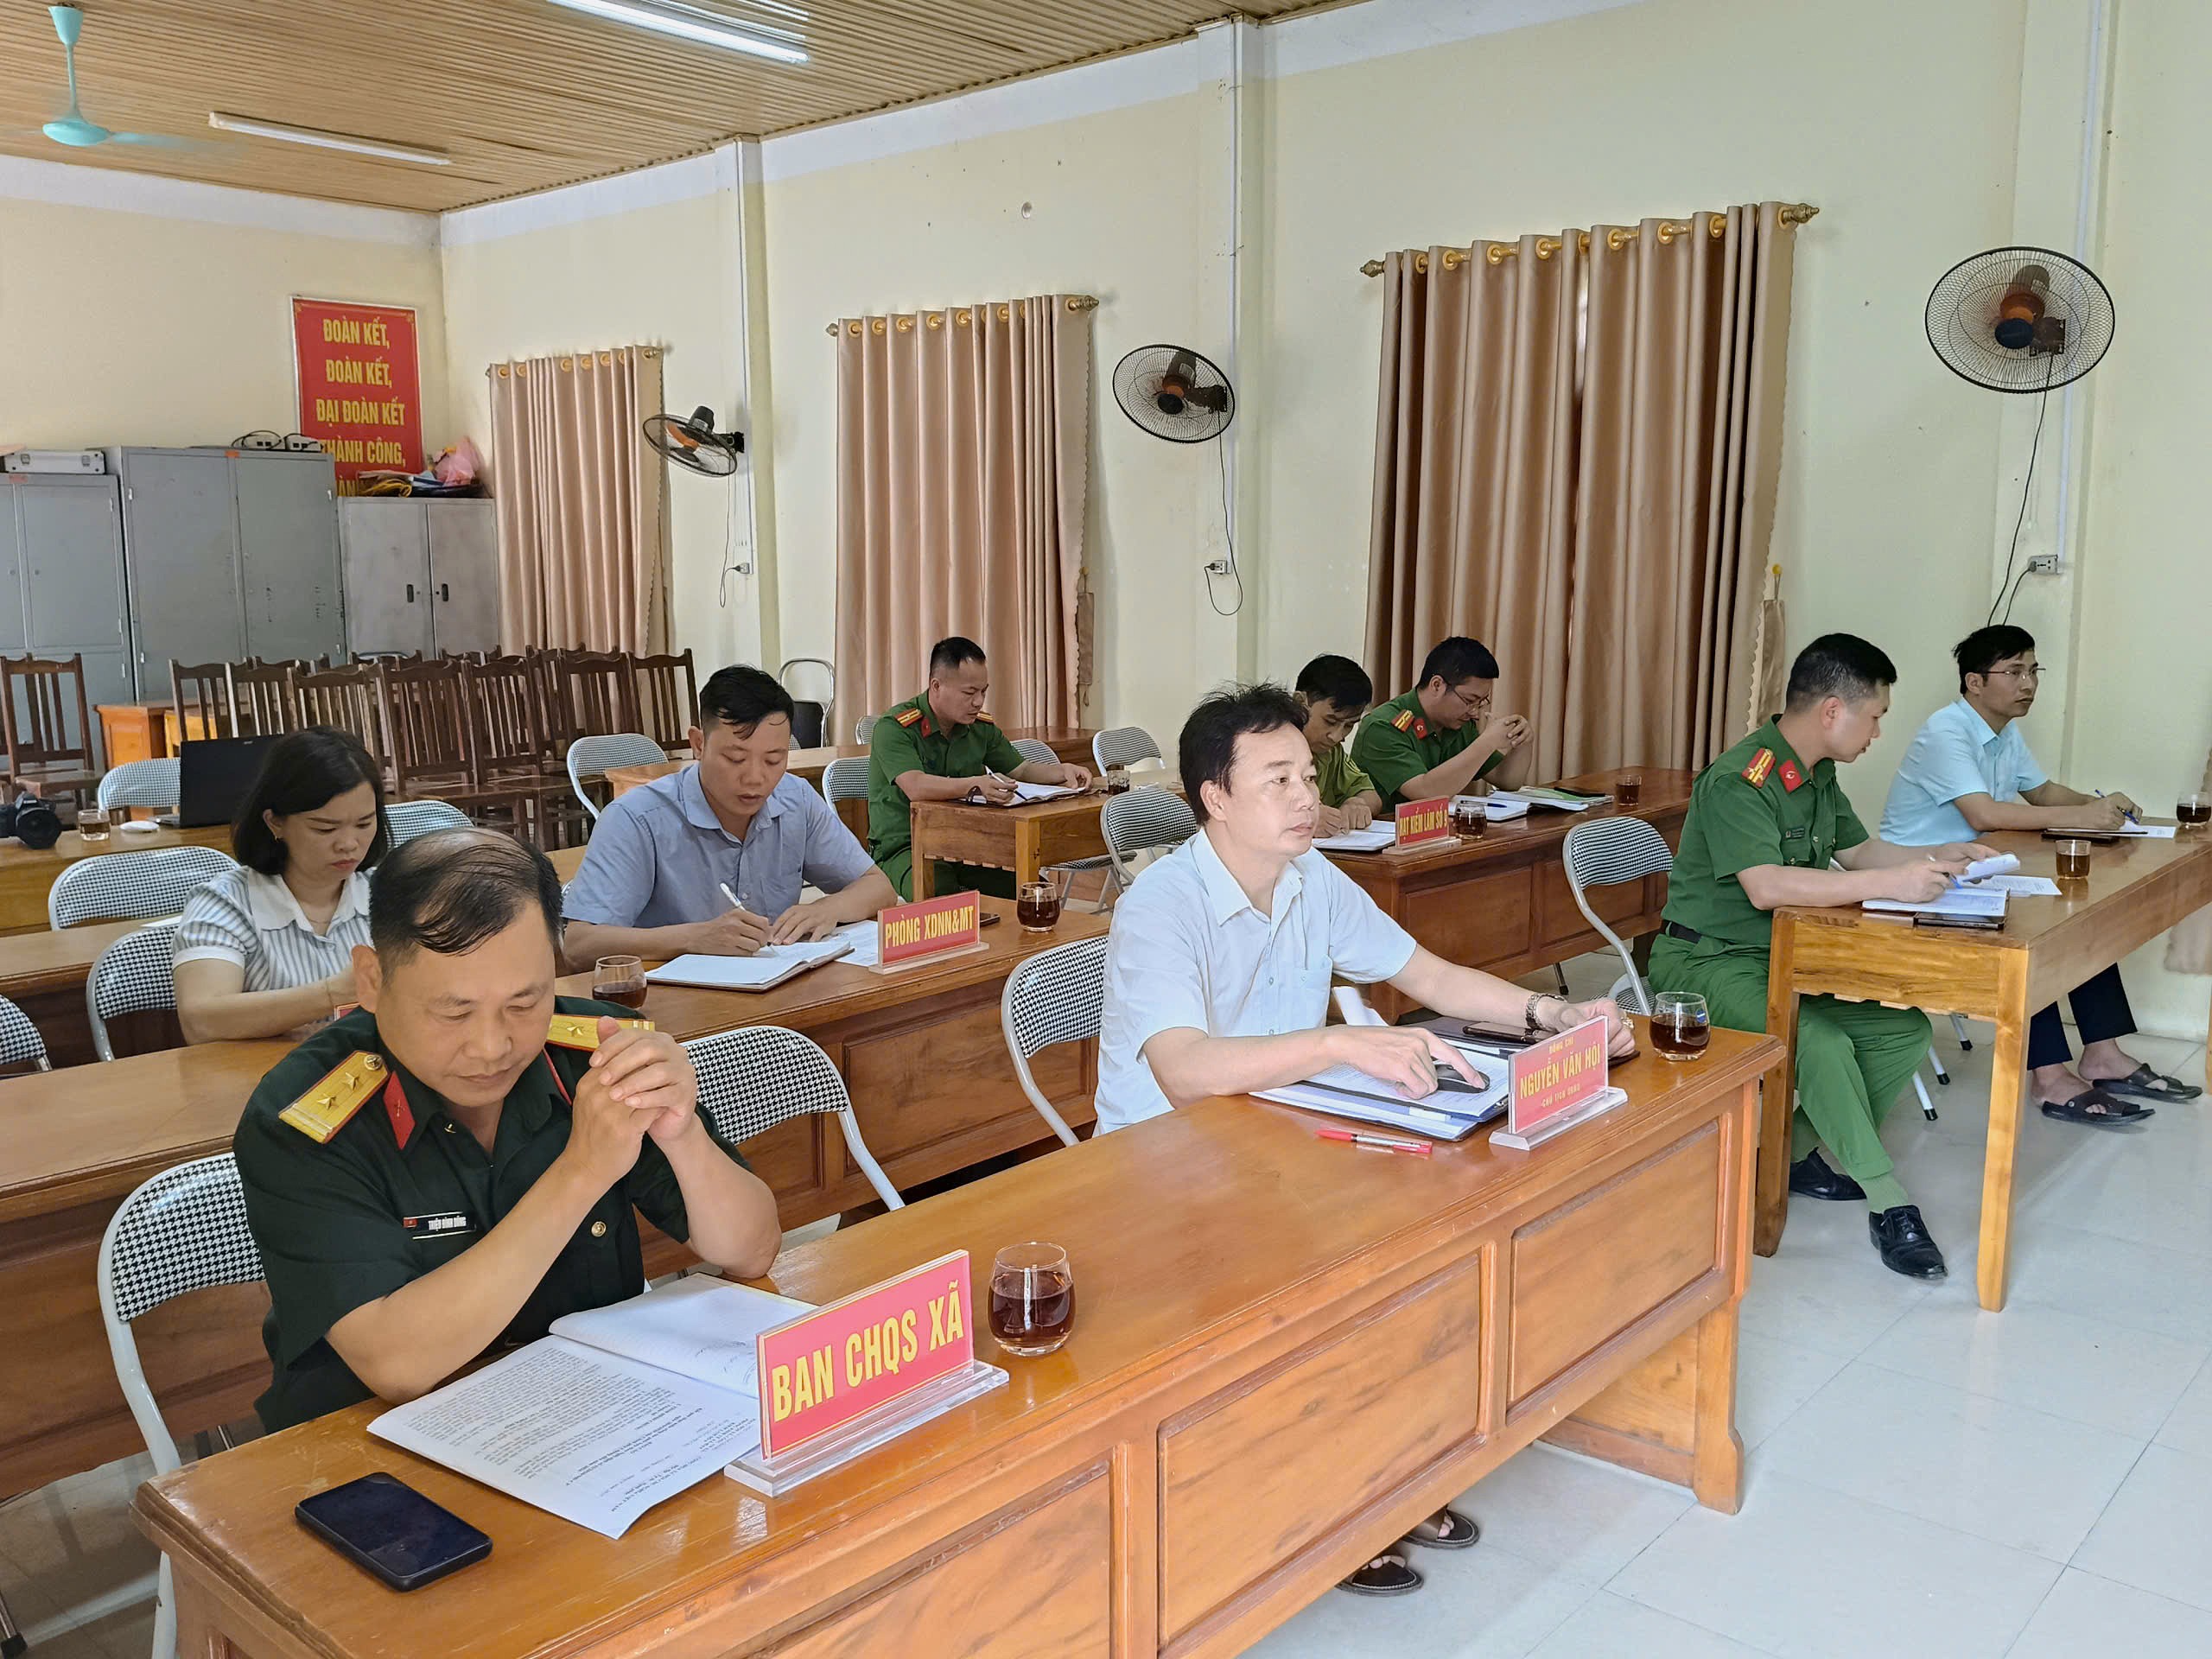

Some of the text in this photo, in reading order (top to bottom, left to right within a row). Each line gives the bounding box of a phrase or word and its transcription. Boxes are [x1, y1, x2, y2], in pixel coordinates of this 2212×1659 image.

[323, 315, 391, 349] ĐOÀN KẾT,
[326, 356, 392, 389] ĐOÀN KẾT,
[316, 396, 405, 427] ĐẠI ĐOÀN KẾT
[366, 436, 406, 467] CÔNG,
[885, 906, 974, 949] PHÒNG XDNN&MT
[1520, 1041, 1600, 1099] NGUYỄN VĂN HỘI
[772, 1344, 835, 1423] BAN
[845, 1309, 918, 1389] CHQS
[928, 1279, 964, 1351] XÃ
